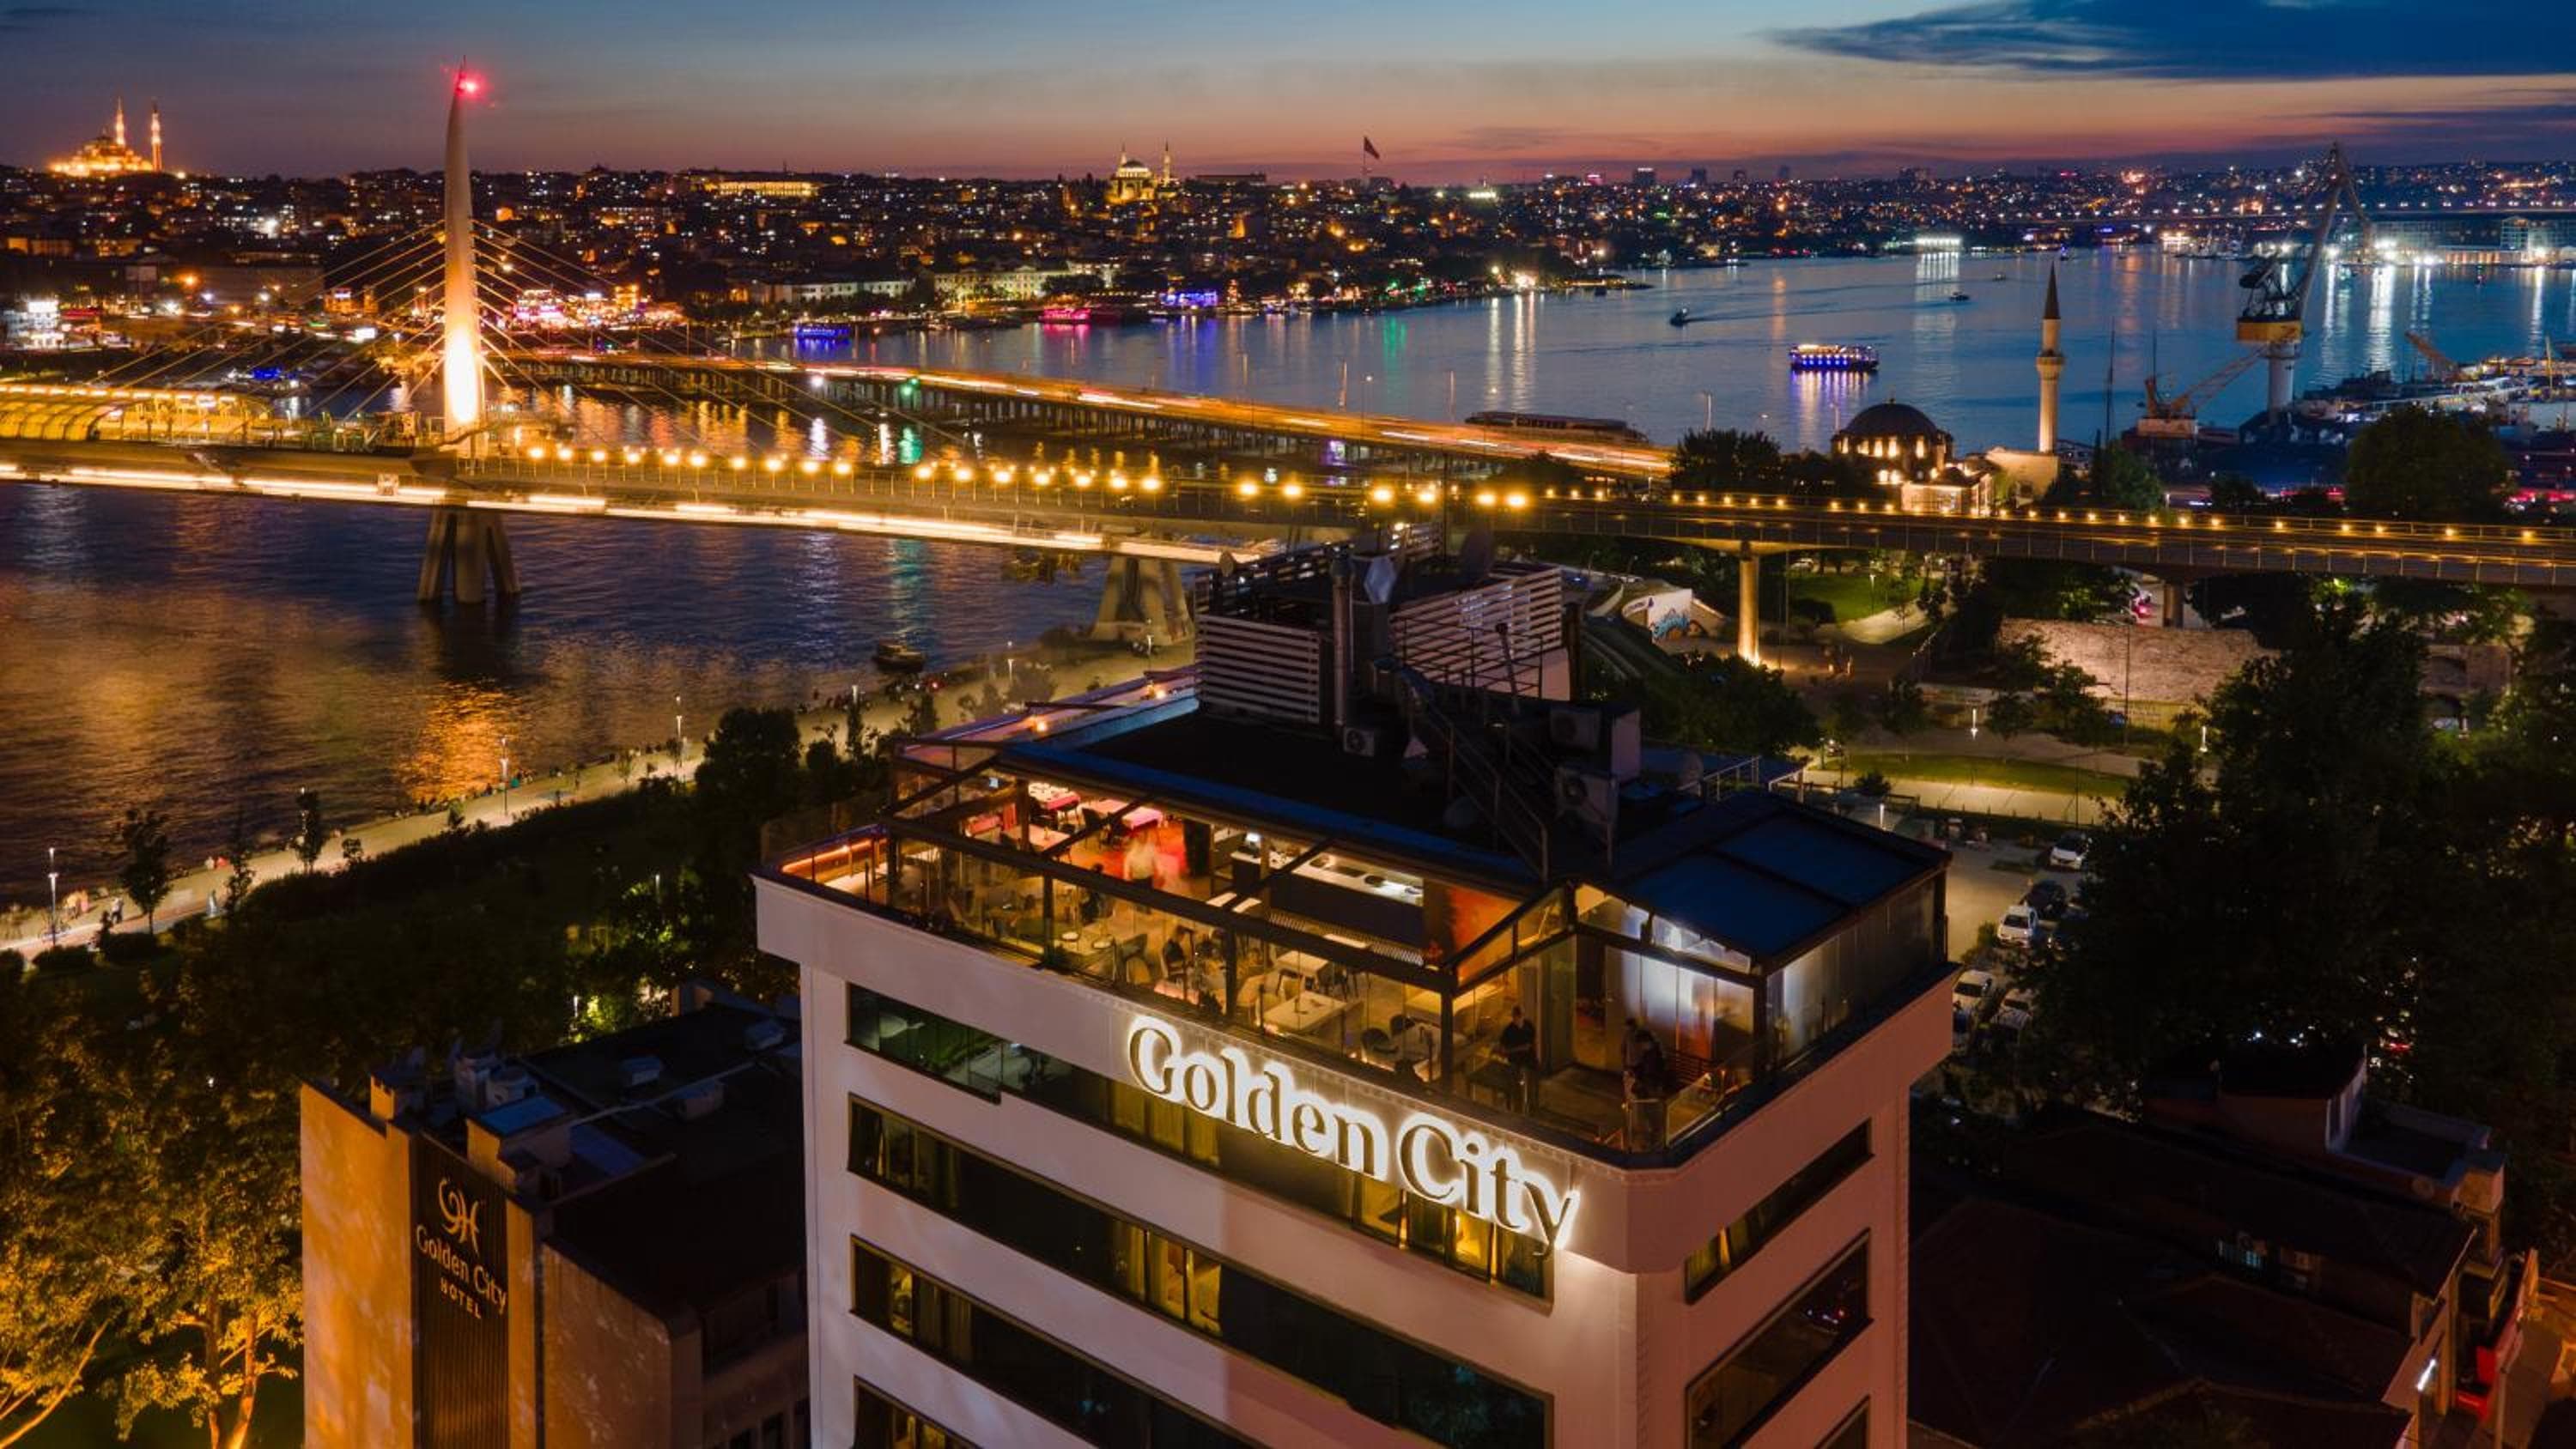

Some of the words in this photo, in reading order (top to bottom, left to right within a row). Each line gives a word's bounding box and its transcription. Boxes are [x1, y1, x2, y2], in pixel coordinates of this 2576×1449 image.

[1127, 1020, 1384, 1179] Golden
[1398, 1114, 1577, 1256] City
[416, 1224, 470, 1283] Golden
[474, 1264, 508, 1314] City
[440, 1276, 482, 1319] HOTEL
